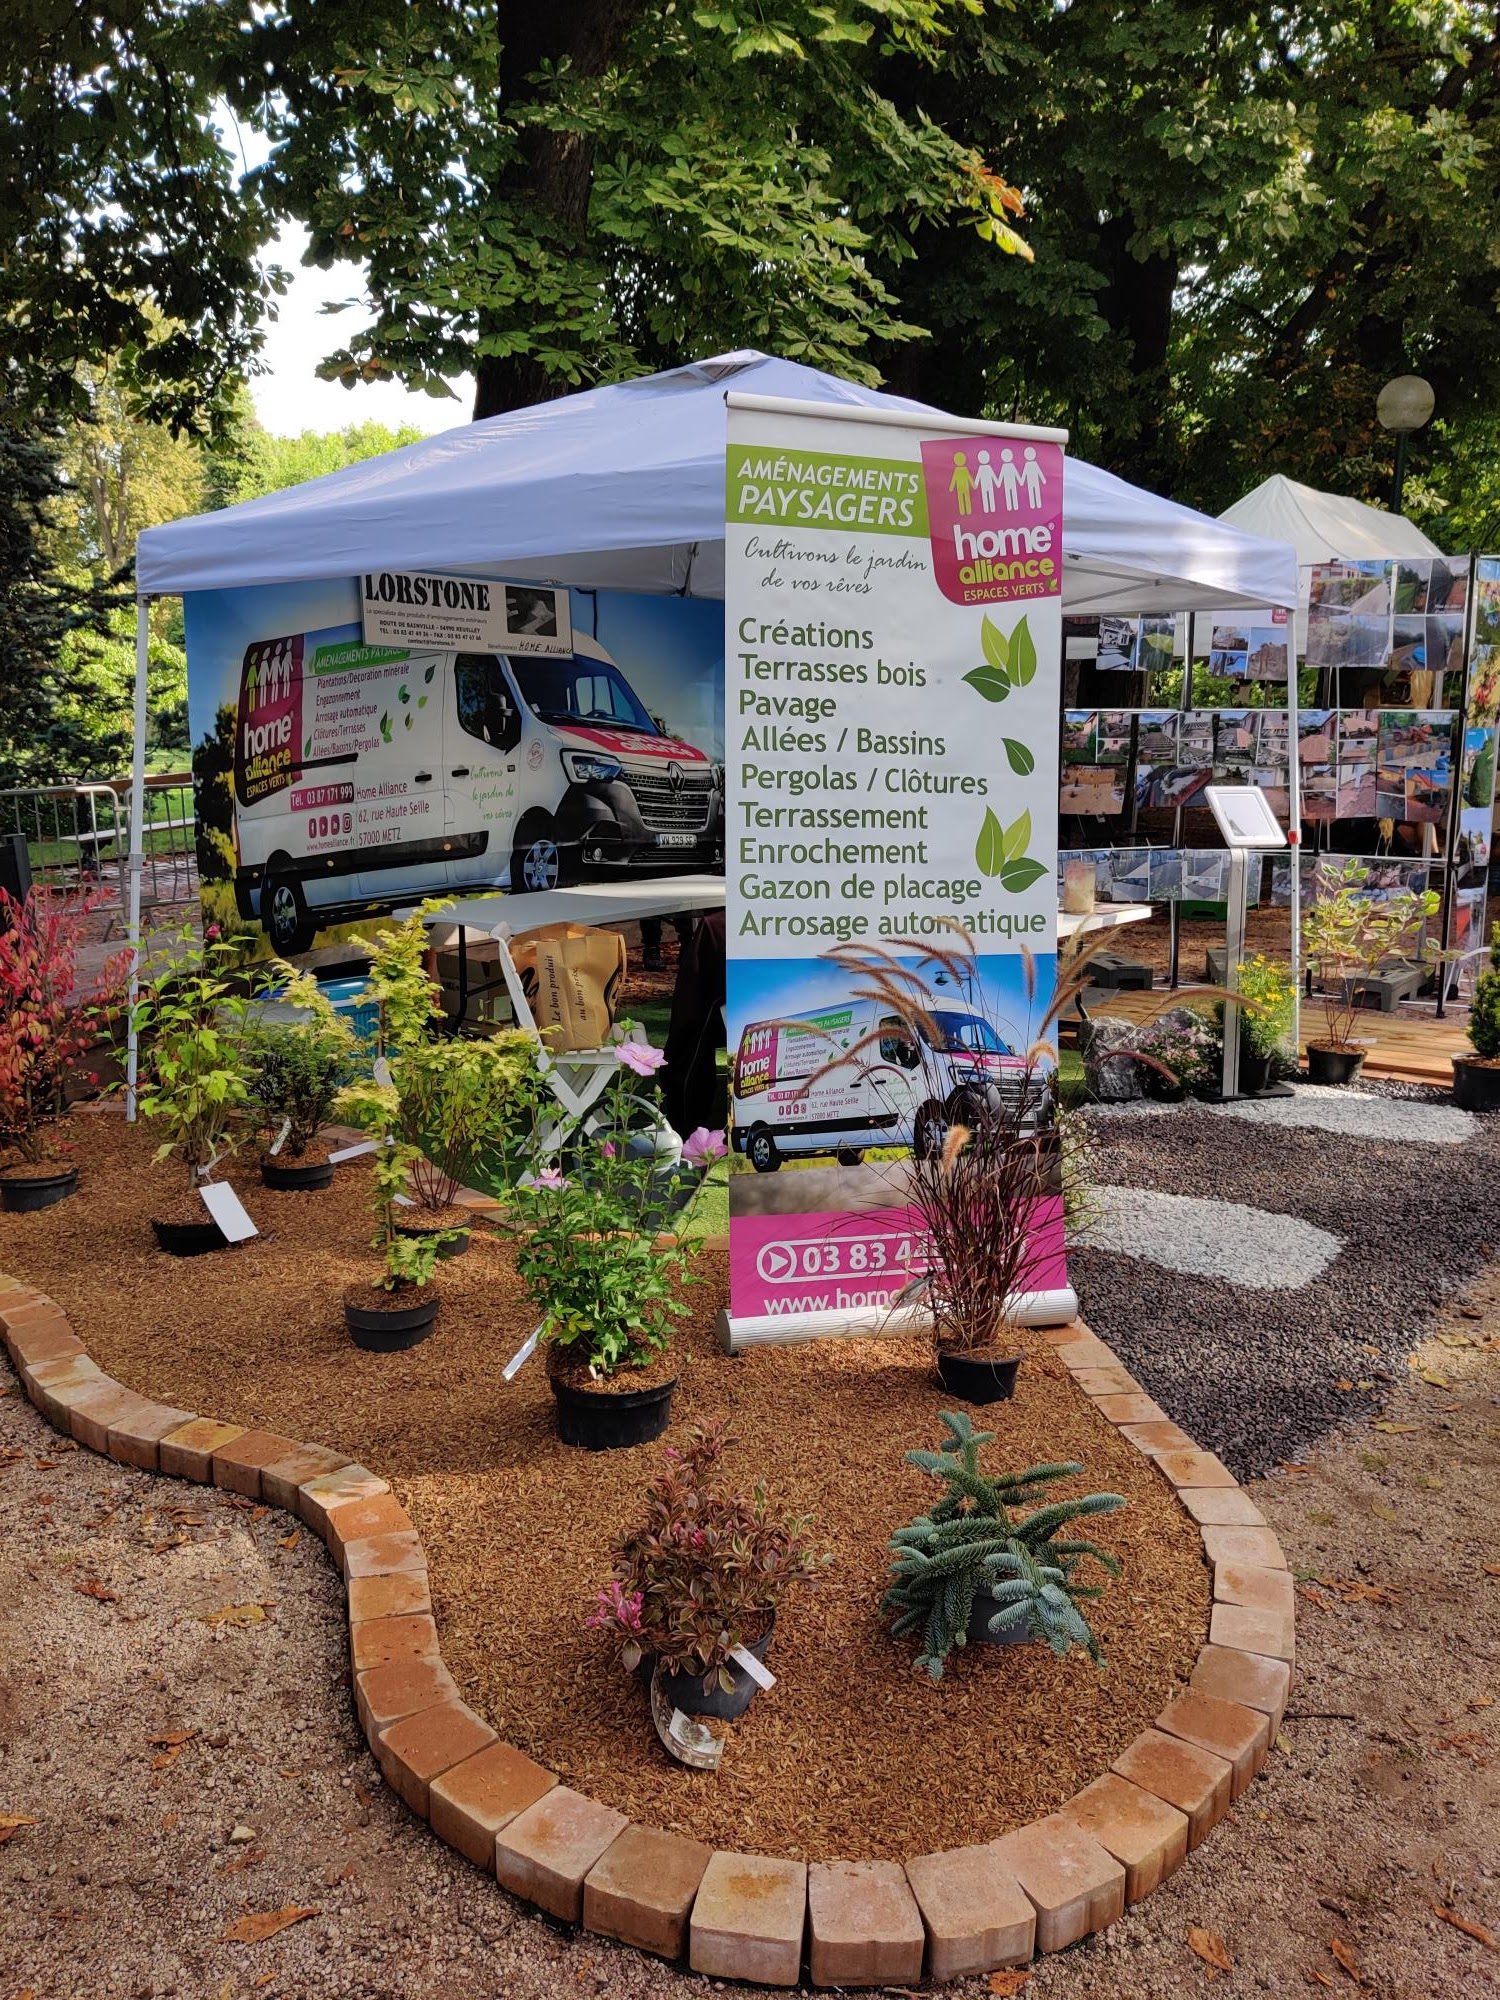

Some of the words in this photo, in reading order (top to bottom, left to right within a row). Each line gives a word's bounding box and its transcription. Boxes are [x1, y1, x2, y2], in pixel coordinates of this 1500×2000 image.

[737, 456, 918, 494] AMÉNAGEMENTS
[738, 485, 914, 527] PAYSAGERS
[953, 525, 1052, 560] home
[745, 536, 838, 565] Cultivons
[846, 545, 862, 566] le
[864, 550, 927, 579] jardin
[959, 558, 1054, 585] alliance
[365, 573, 490, 611] LORSTONE
[761, 568, 785, 589] de
[790, 578, 820, 592] vos
[827, 575, 872, 595] rêves
[964, 586, 1009, 601] ESPACES
[1012, 582, 1045, 596] VERTS
[519, 641, 542, 652] HOME
[738, 617, 874, 650] Créations
[738, 653, 868, 683] Terrasses
[877, 659, 927, 687] bois
[315, 709, 339, 723] Arrosage
[340, 704, 378, 719] automatique
[739, 689, 837, 723] Pavage
[244, 715, 292, 760] home
[741, 726, 827, 752] Allées
[857, 727, 946, 756] Bassins
[245, 748, 291, 781] alliance
[246, 779, 268, 799] ESPACES
[268, 773, 285, 788] VERTS
[356, 787, 377, 799] Home
[378, 781, 407, 797] Alliance
[741, 764, 857, 796] Pergolas
[885, 768, 988, 796] Clôtures
[306, 791, 315, 805] 03
[315, 790, 325, 803] 87
[327, 788, 338, 801] 171
[340, 786, 353, 799] 999
[371, 810, 384, 820] rue
[386, 804, 407, 818] Haute
[409, 801, 430, 815] Seille
[738, 801, 929, 830] Terrassement
[359, 831, 380, 846] 57000
[382, 827, 401, 843] METZ
[739, 837, 929, 865] Enrochement
[738, 873, 830, 900] Gazon
[840, 873, 875, 899] de
[884, 874, 982, 905] placage
[738, 910, 869, 942] Arrosage
[878, 908, 1047, 940] automatique
[545, 956, 560, 990] produit
[550, 992, 559, 1011] bon
[575, 990, 585, 1006] bon
[552, 1011, 561, 1022] Le
[580, 1008, 587, 1021] au
[740, 1057, 770, 1078] home
[741, 1072, 770, 1088] alliance
[802, 1246, 840, 1274] 03
[850, 1242, 886, 1270] 83
